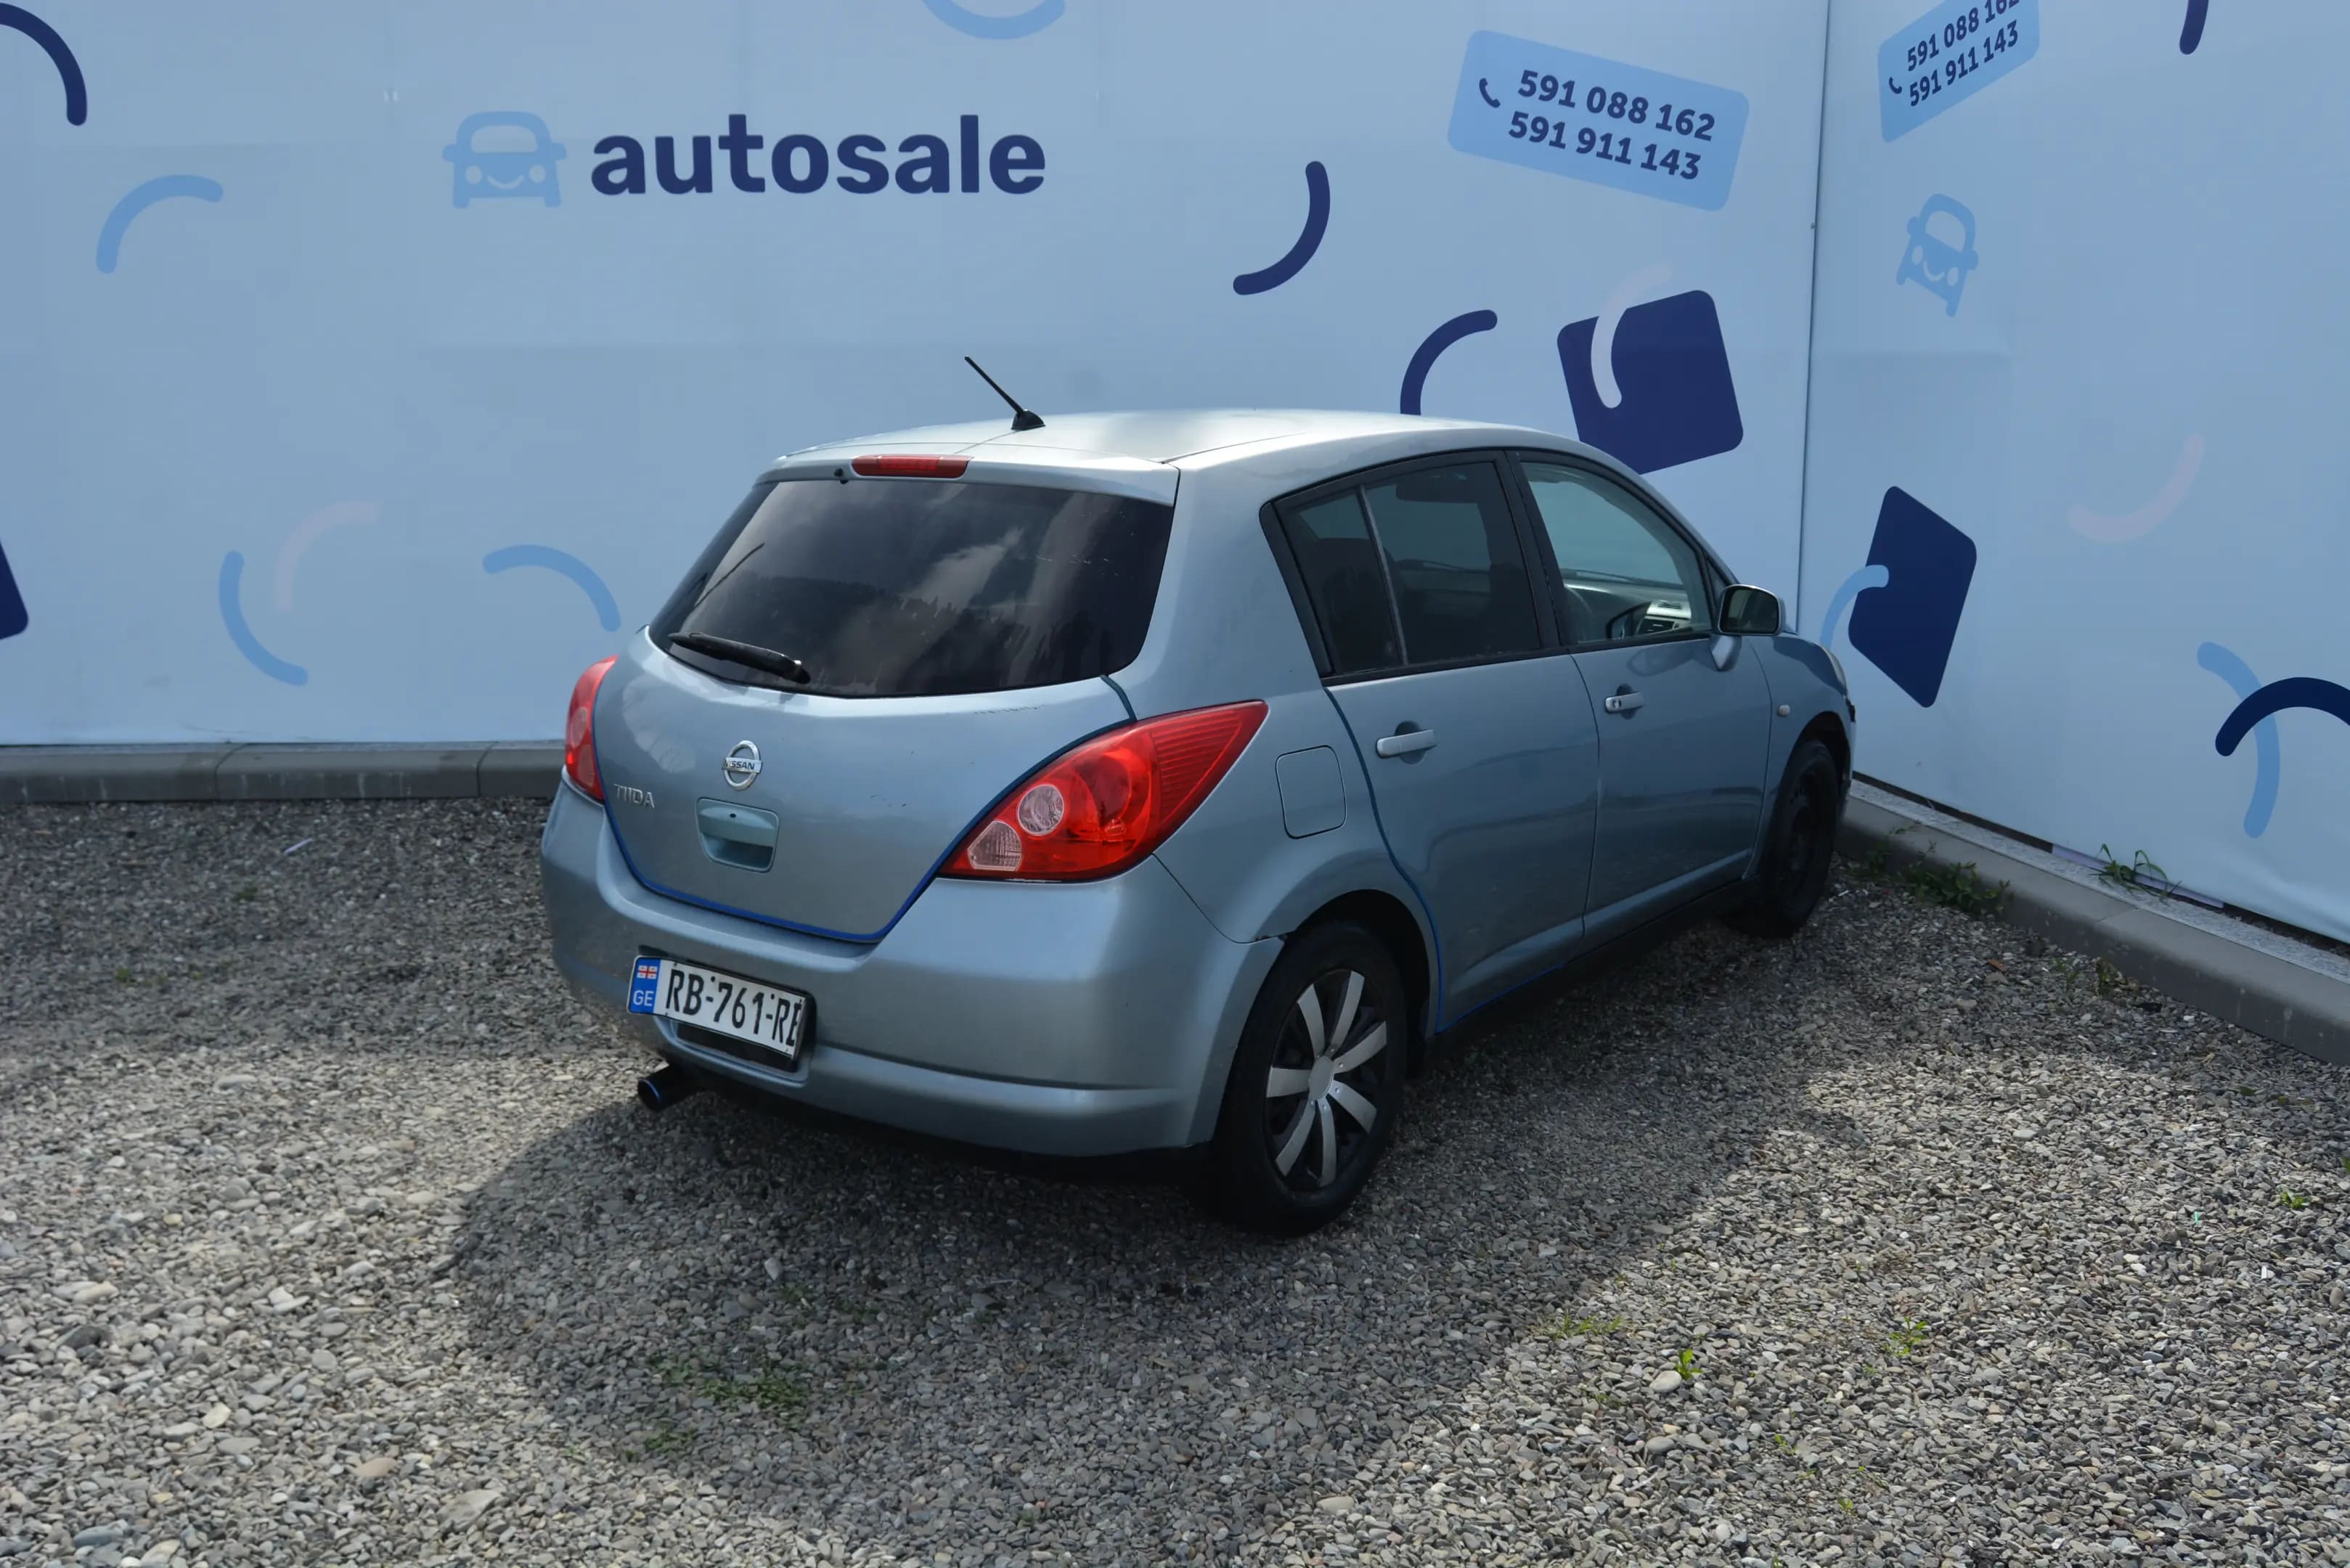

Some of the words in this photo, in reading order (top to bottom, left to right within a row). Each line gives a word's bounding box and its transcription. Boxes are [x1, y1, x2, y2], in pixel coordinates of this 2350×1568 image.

[1907, 33, 1940, 72] 591
[1943, 7, 1980, 49] 088
[1909, 69, 1942, 107] 591
[1945, 46, 1979, 86] 911
[1983, 19, 2018, 64] 143
[1517, 69, 1576, 108] 591
[1586, 86, 1649, 124] 088
[1655, 104, 1715, 142] 162
[591, 113, 1046, 196] autosale
[1508, 110, 1566, 150] 591
[1575, 127, 1632, 165] 911
[1640, 143, 1701, 180] 143
[613, 783, 655, 809] TIIDA
[632, 989, 654, 1007] GE
